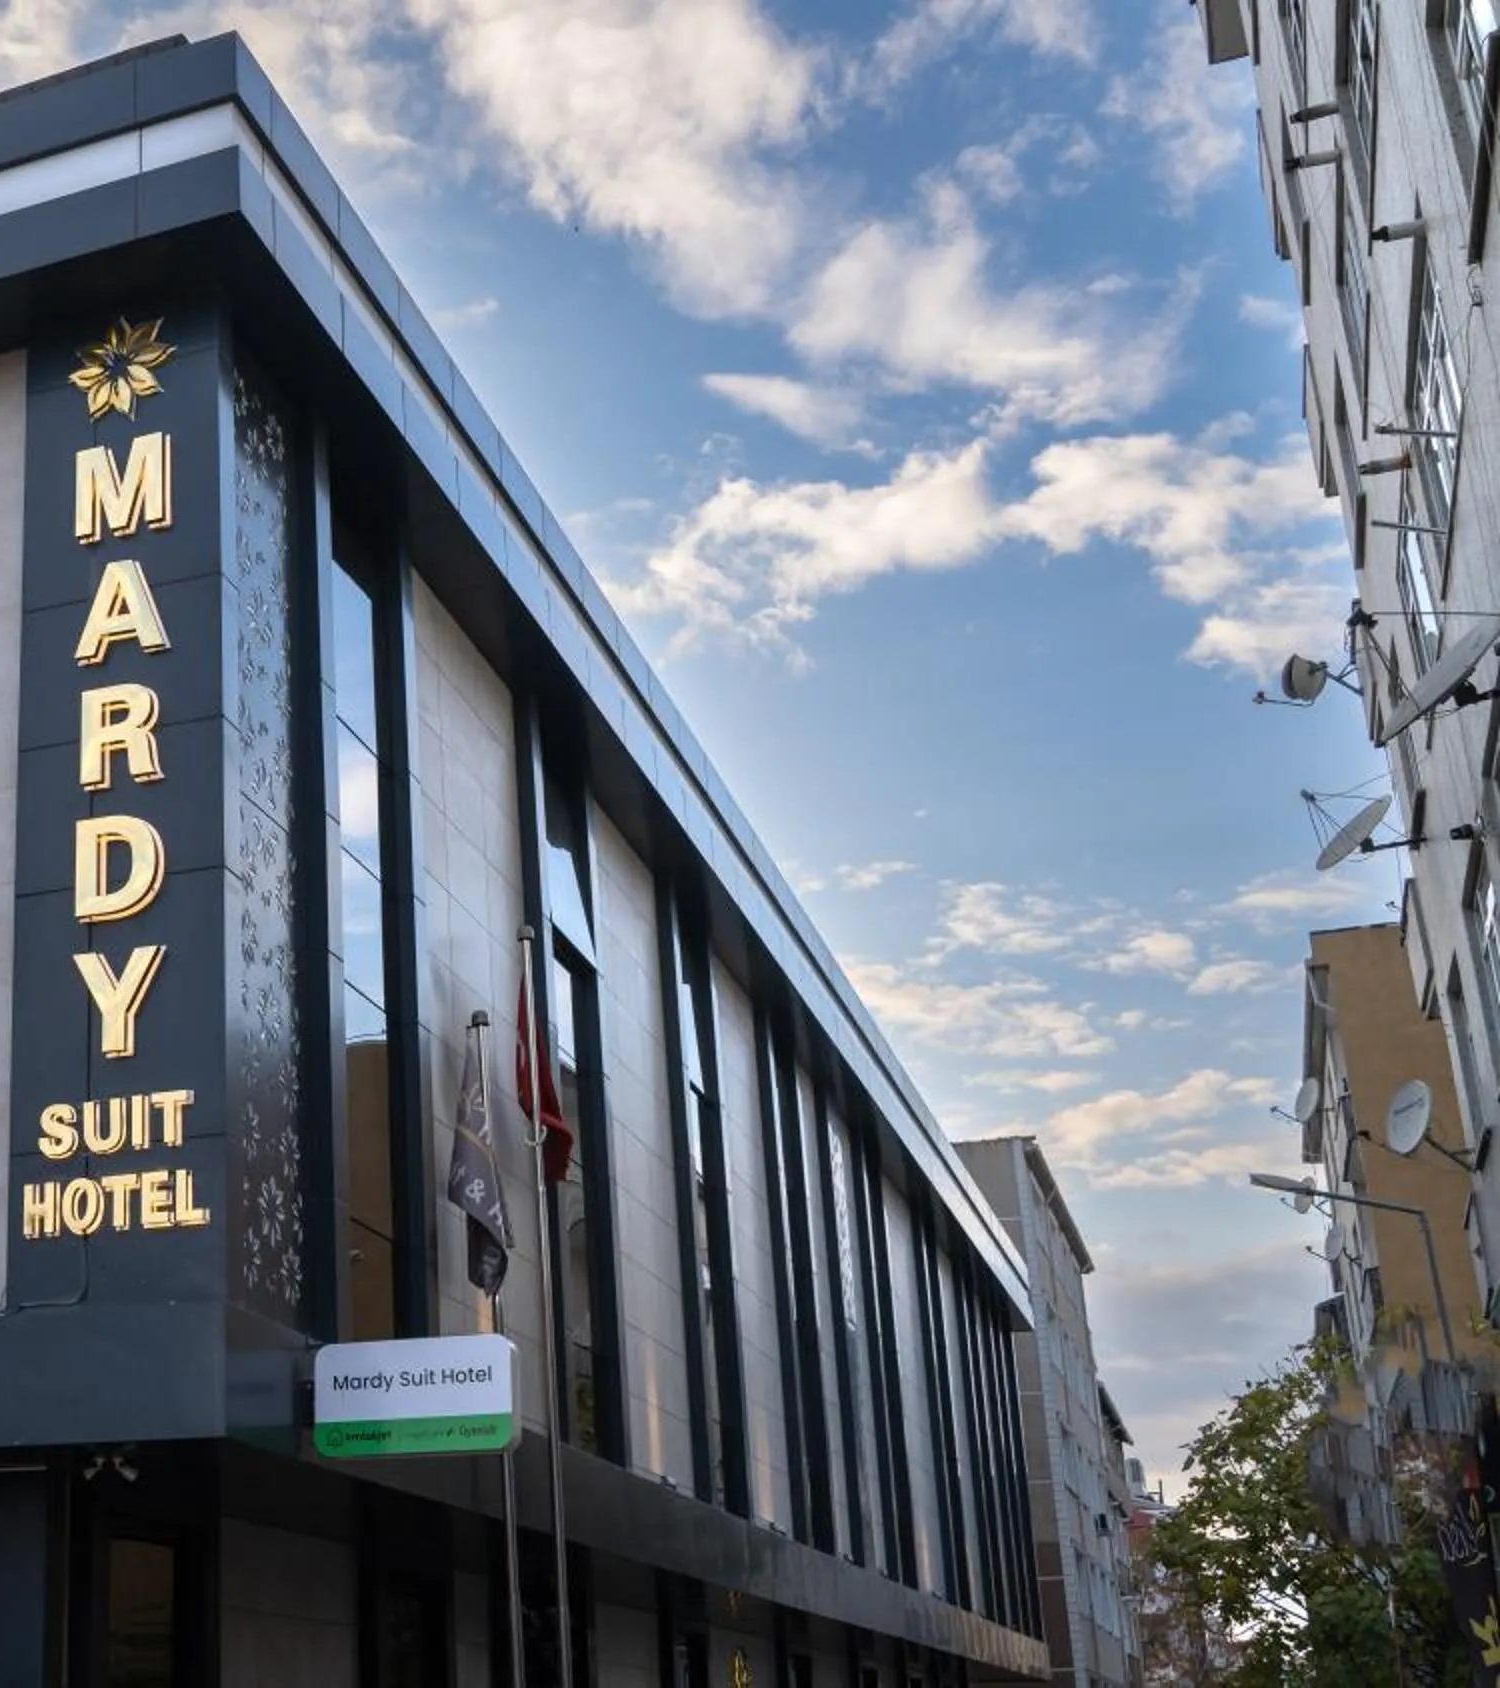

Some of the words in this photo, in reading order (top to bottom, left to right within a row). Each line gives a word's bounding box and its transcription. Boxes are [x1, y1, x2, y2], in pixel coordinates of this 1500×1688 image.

[73, 431, 172, 1060] MARDY
[38, 1089, 195, 1159] SUIT
[23, 1169, 211, 1239] HOTEL
[332, 1371, 394, 1393] Mardy
[400, 1368, 436, 1387] Suit
[441, 1365, 493, 1385] Hotel
